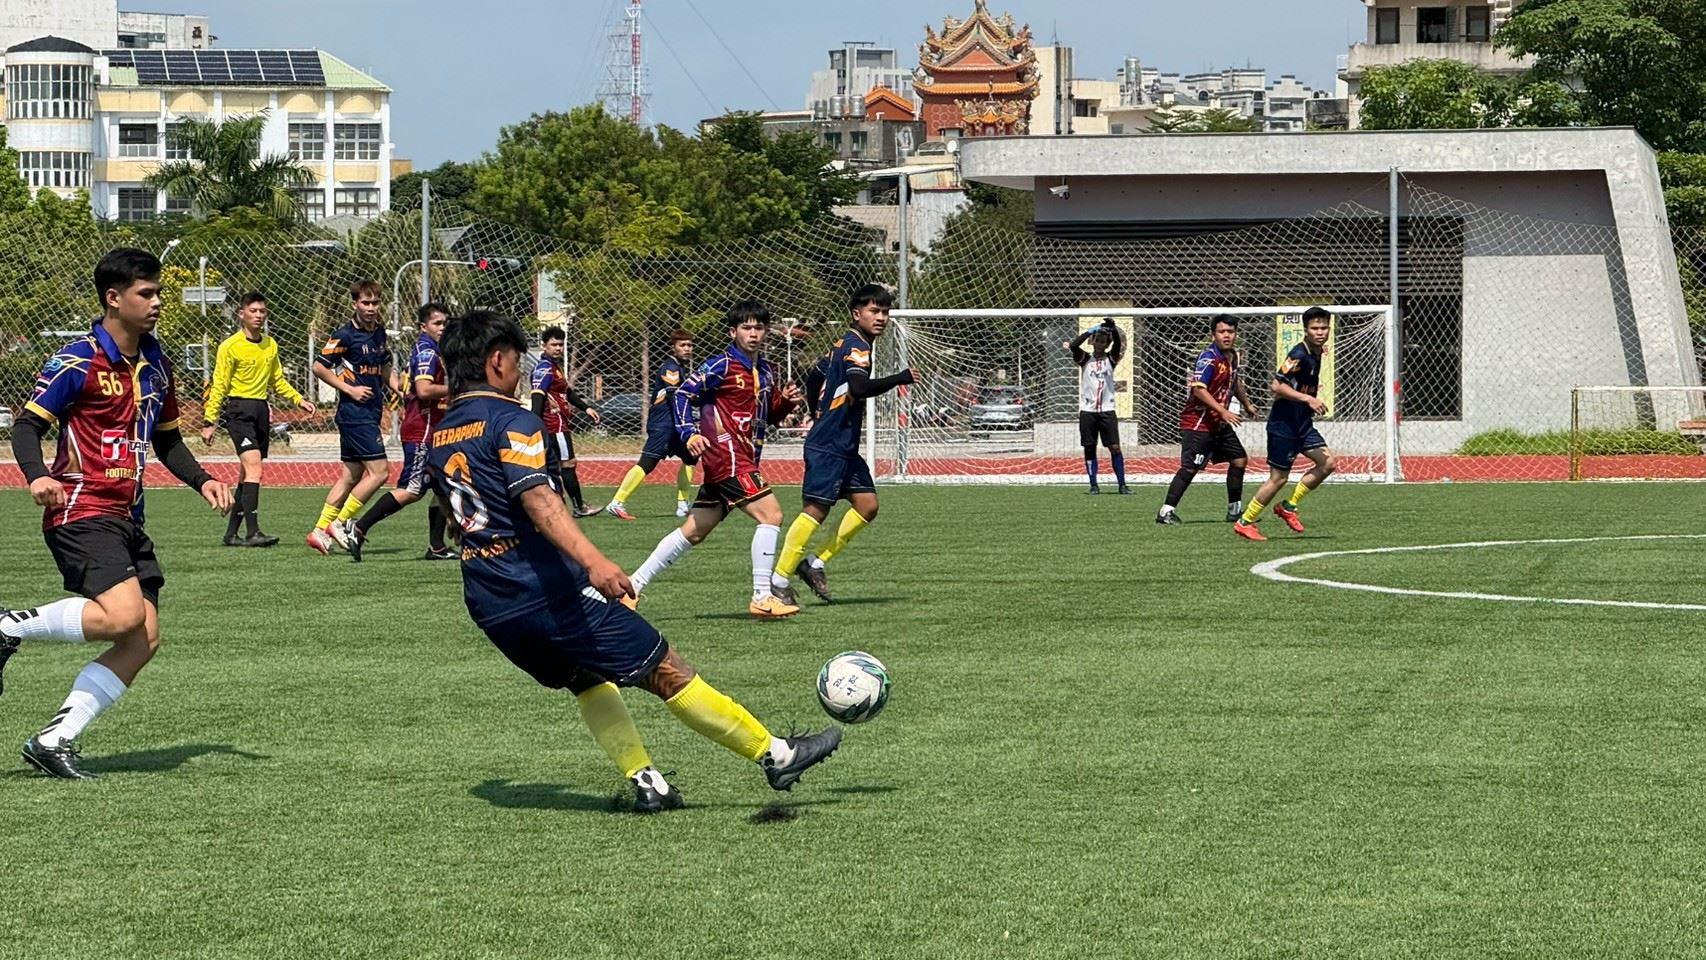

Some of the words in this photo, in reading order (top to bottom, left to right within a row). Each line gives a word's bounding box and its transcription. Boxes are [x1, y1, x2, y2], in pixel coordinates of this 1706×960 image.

[97, 371, 124, 396] 56
[735, 373, 746, 389] 5
[1193, 453, 1205, 465] 10
